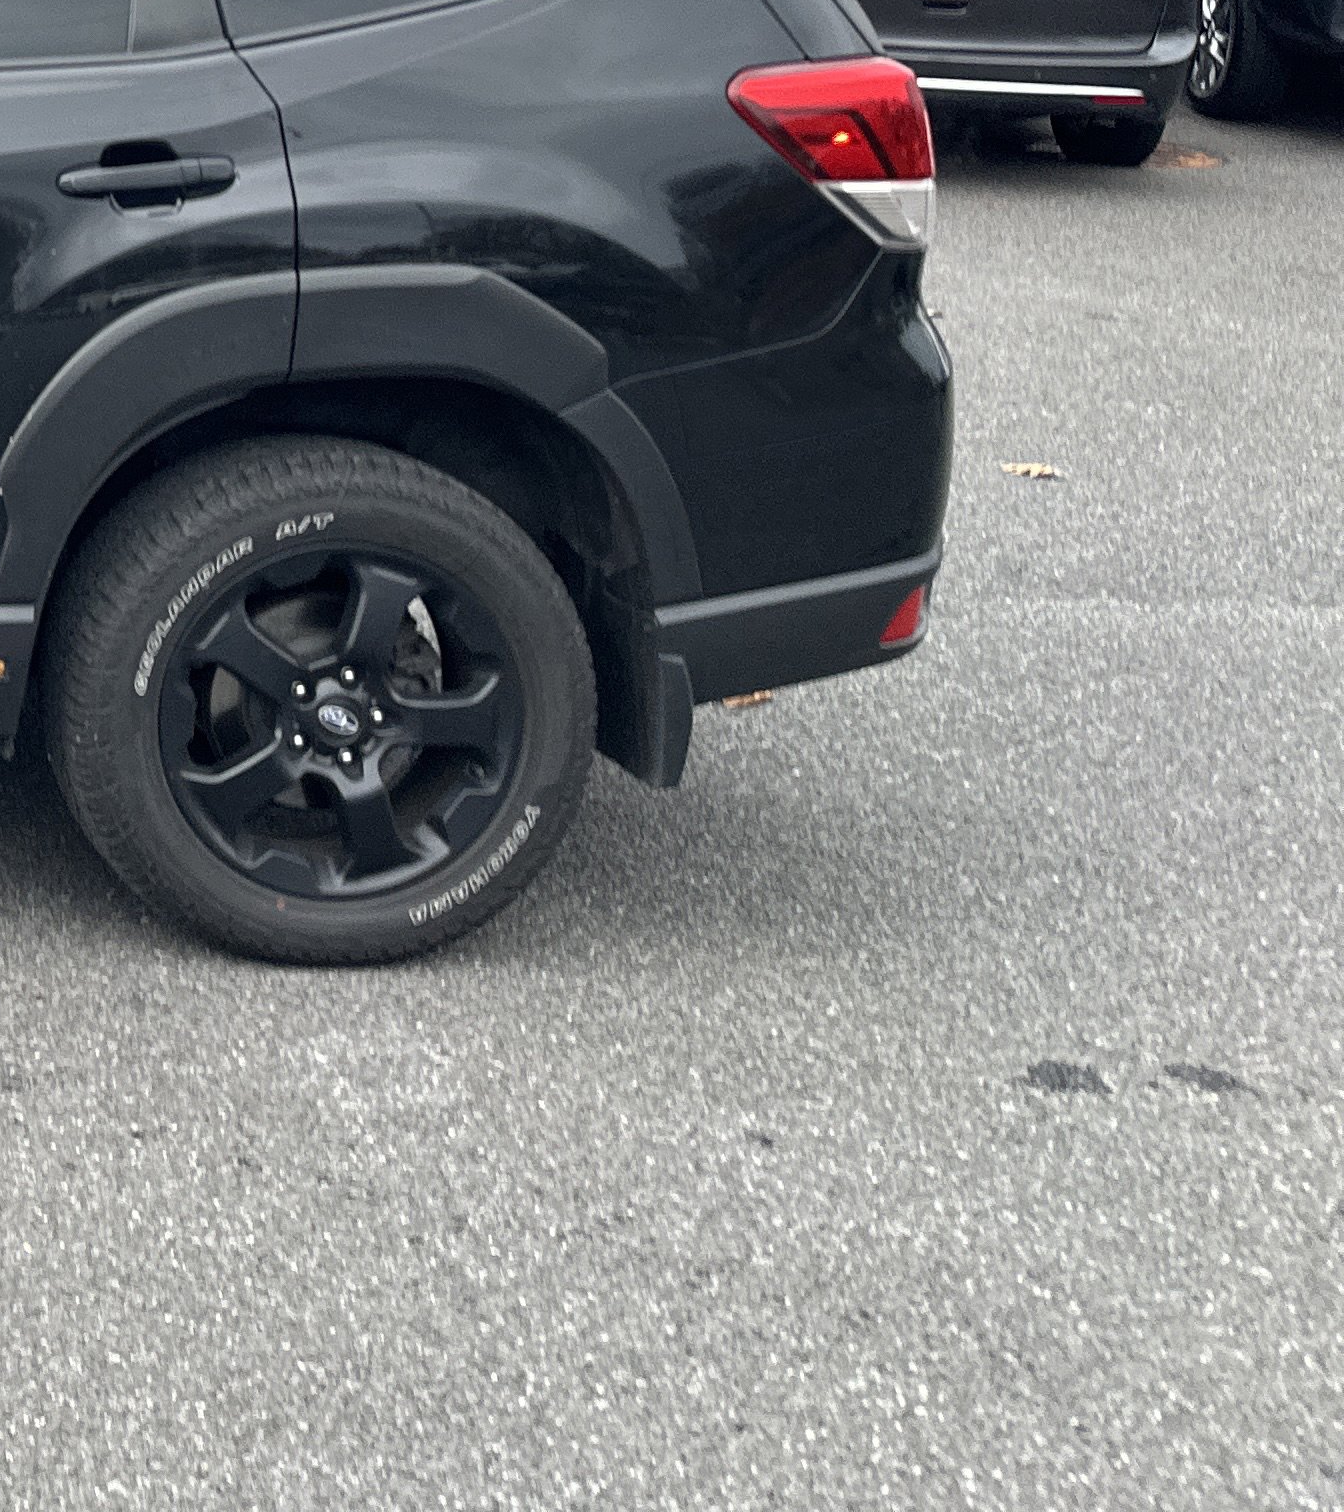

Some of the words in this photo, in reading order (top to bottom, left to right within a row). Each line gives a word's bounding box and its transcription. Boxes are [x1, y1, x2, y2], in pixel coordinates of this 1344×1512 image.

[134, 535, 254, 697] GEOLANDAR
[275, 511, 335, 541] A/T
[407, 803, 542, 928] YOKOHAMA
